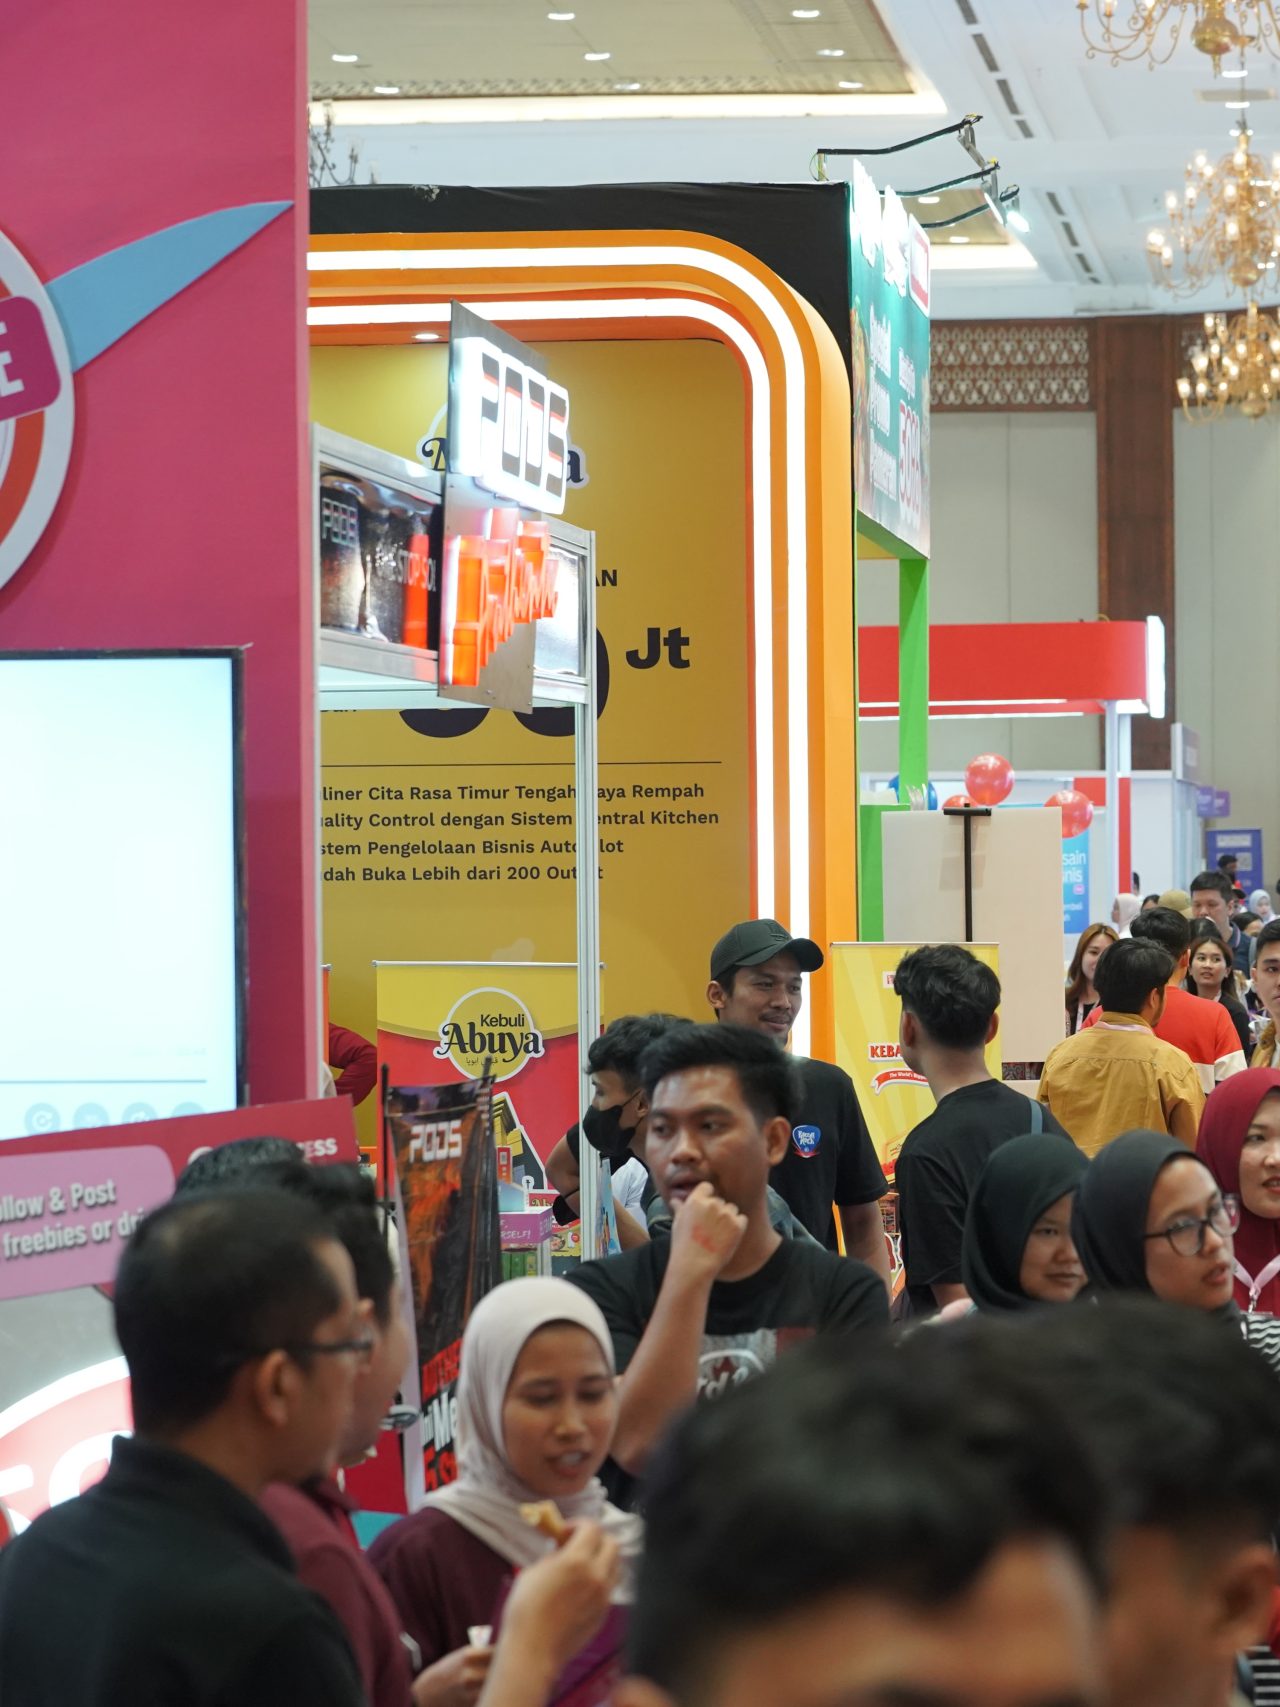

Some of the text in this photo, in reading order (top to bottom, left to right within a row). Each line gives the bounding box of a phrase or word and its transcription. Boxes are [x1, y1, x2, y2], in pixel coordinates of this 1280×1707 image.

[450, 336, 570, 515] PODS
[625, 627, 691, 669] Jt
[321, 783, 705, 802] liner Cita Rasa Timur Tengah aya Rempah
[320, 813, 363, 831] ality
[368, 812, 435, 827] Control
[440, 812, 505, 830] dengan
[511, 811, 573, 826] Sistem
[651, 809, 719, 825] Kitchen
[367, 840, 476, 858] Pengelolaan
[482, 840, 535, 854] Bisnis
[321, 867, 356, 881] dah
[362, 867, 406, 881] Buka
[412, 866, 460, 881] Lebih
[466, 866, 501, 881] dari
[506, 866, 541, 880] 200
[480, 1014, 525, 1028] Kebuli
[436, 1021, 541, 1063] Abuya
[409, 1120, 462, 1163] PODS
[49, 1187, 65, 1213] &
[71, 1179, 117, 1208] Post
[3, 1221, 87, 1257] freebies
[92, 1221, 112, 1241] or
